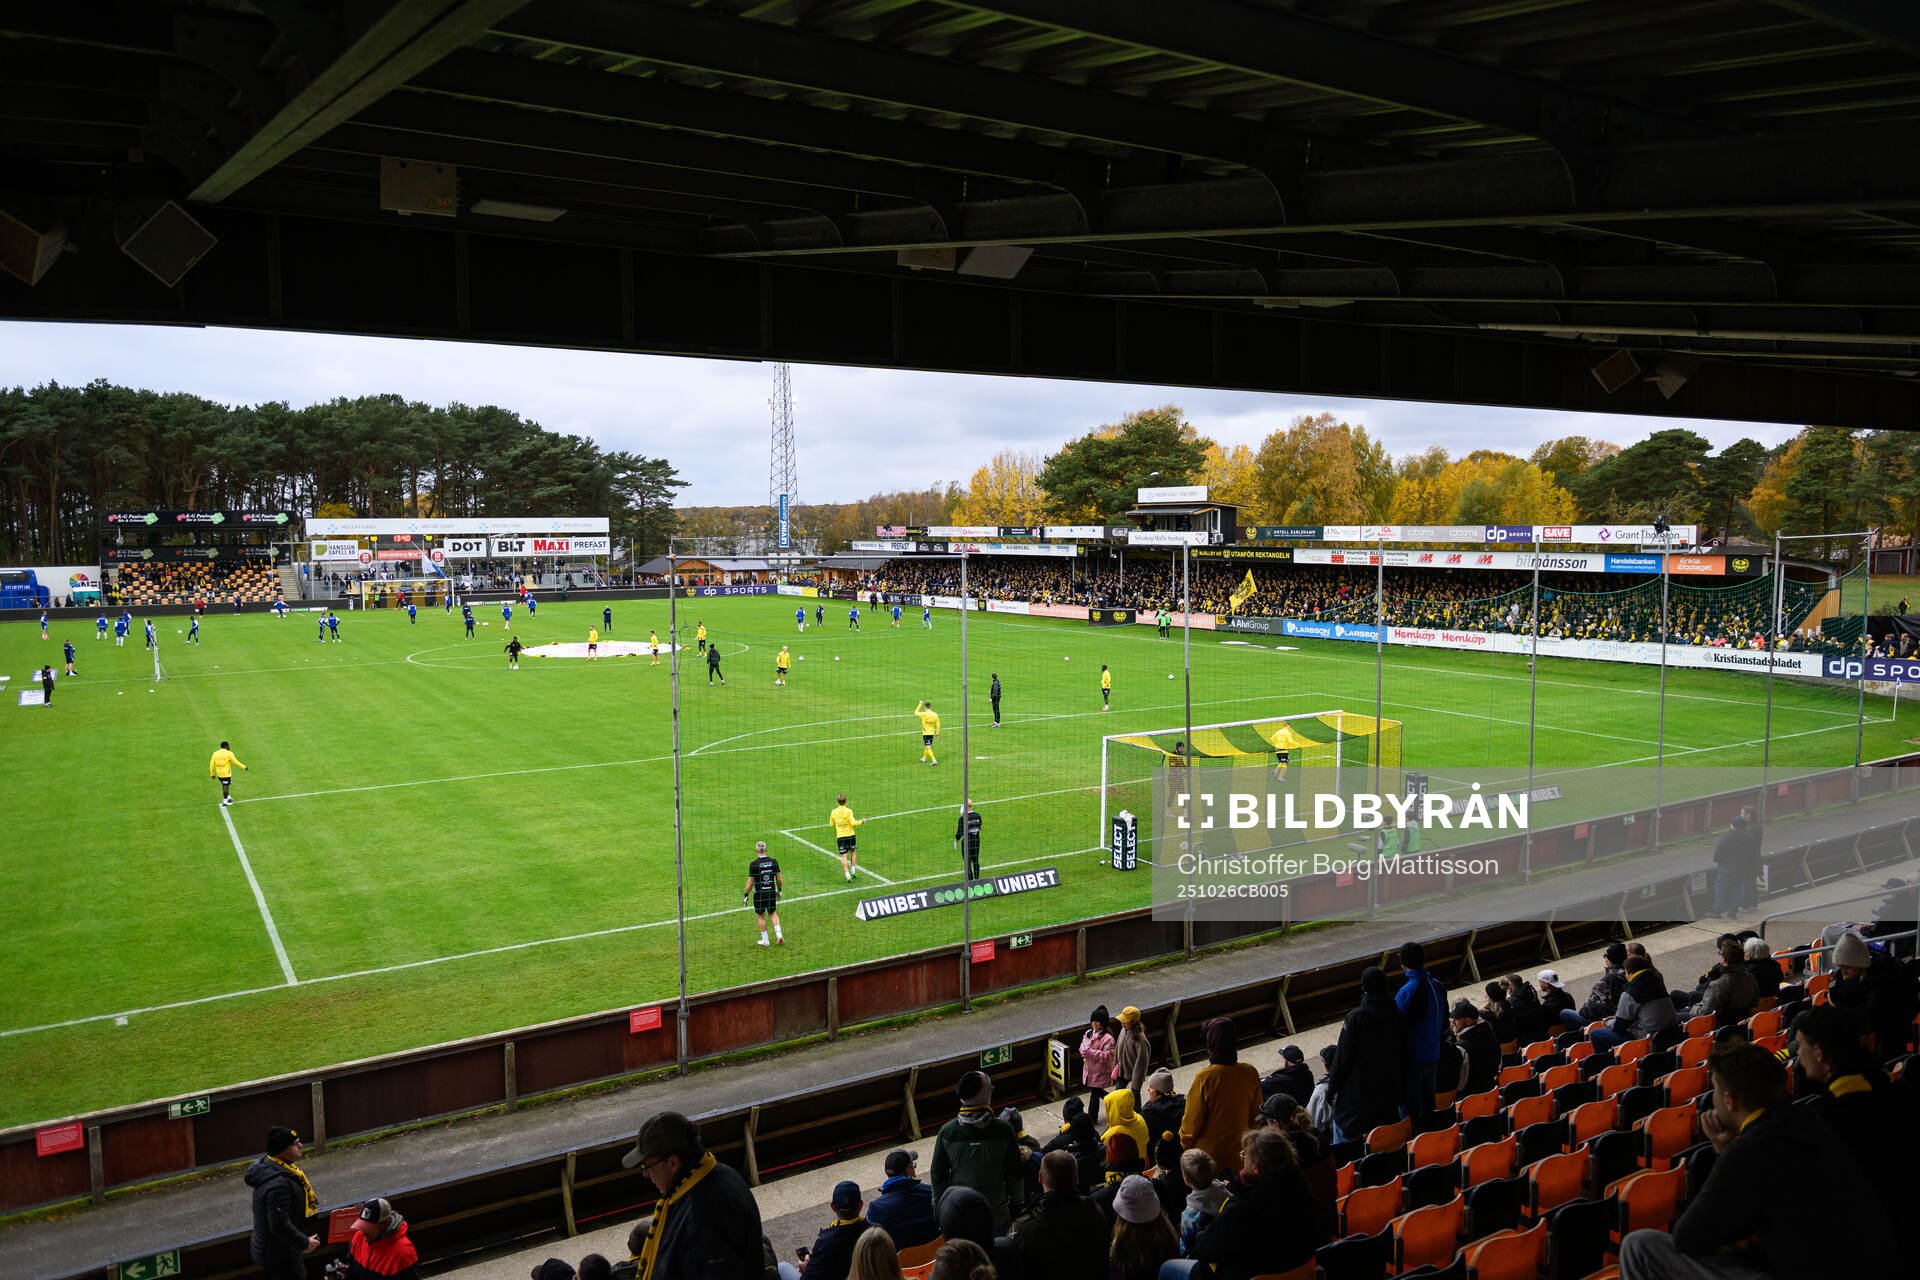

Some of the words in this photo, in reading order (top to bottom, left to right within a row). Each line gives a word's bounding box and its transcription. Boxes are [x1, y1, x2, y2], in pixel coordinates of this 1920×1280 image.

[1486, 526, 1507, 543] dp
[1544, 528, 1570, 537] SAVE
[1615, 530, 1639, 539] Grant
[498, 541, 525, 552] BLT
[1255, 551, 1290, 559] REKTANGELN
[1516, 554, 1588, 569] bilmånsson
[1678, 564, 1712, 572] Elbolaget
[704, 587, 717, 596] dp
[725, 586, 767, 594] SPORTS
[1236, 619, 1269, 630] AlviGroup
[1296, 626, 1330, 635] LARSSON
[1394, 629, 1436, 641] Hemköp
[1442, 632, 1486, 645] Hemköp
[1713, 653, 1802, 669] Kristianstadsbladet
[1829, 657, 1863, 679] dp
[1113, 823, 1123, 869] SELECT
[1126, 826, 1136, 869] SELECT
[997, 870, 1056, 894] UNIBET
[865, 892, 928, 917] UNIBET
[1051, 1049, 1061, 1070] S
